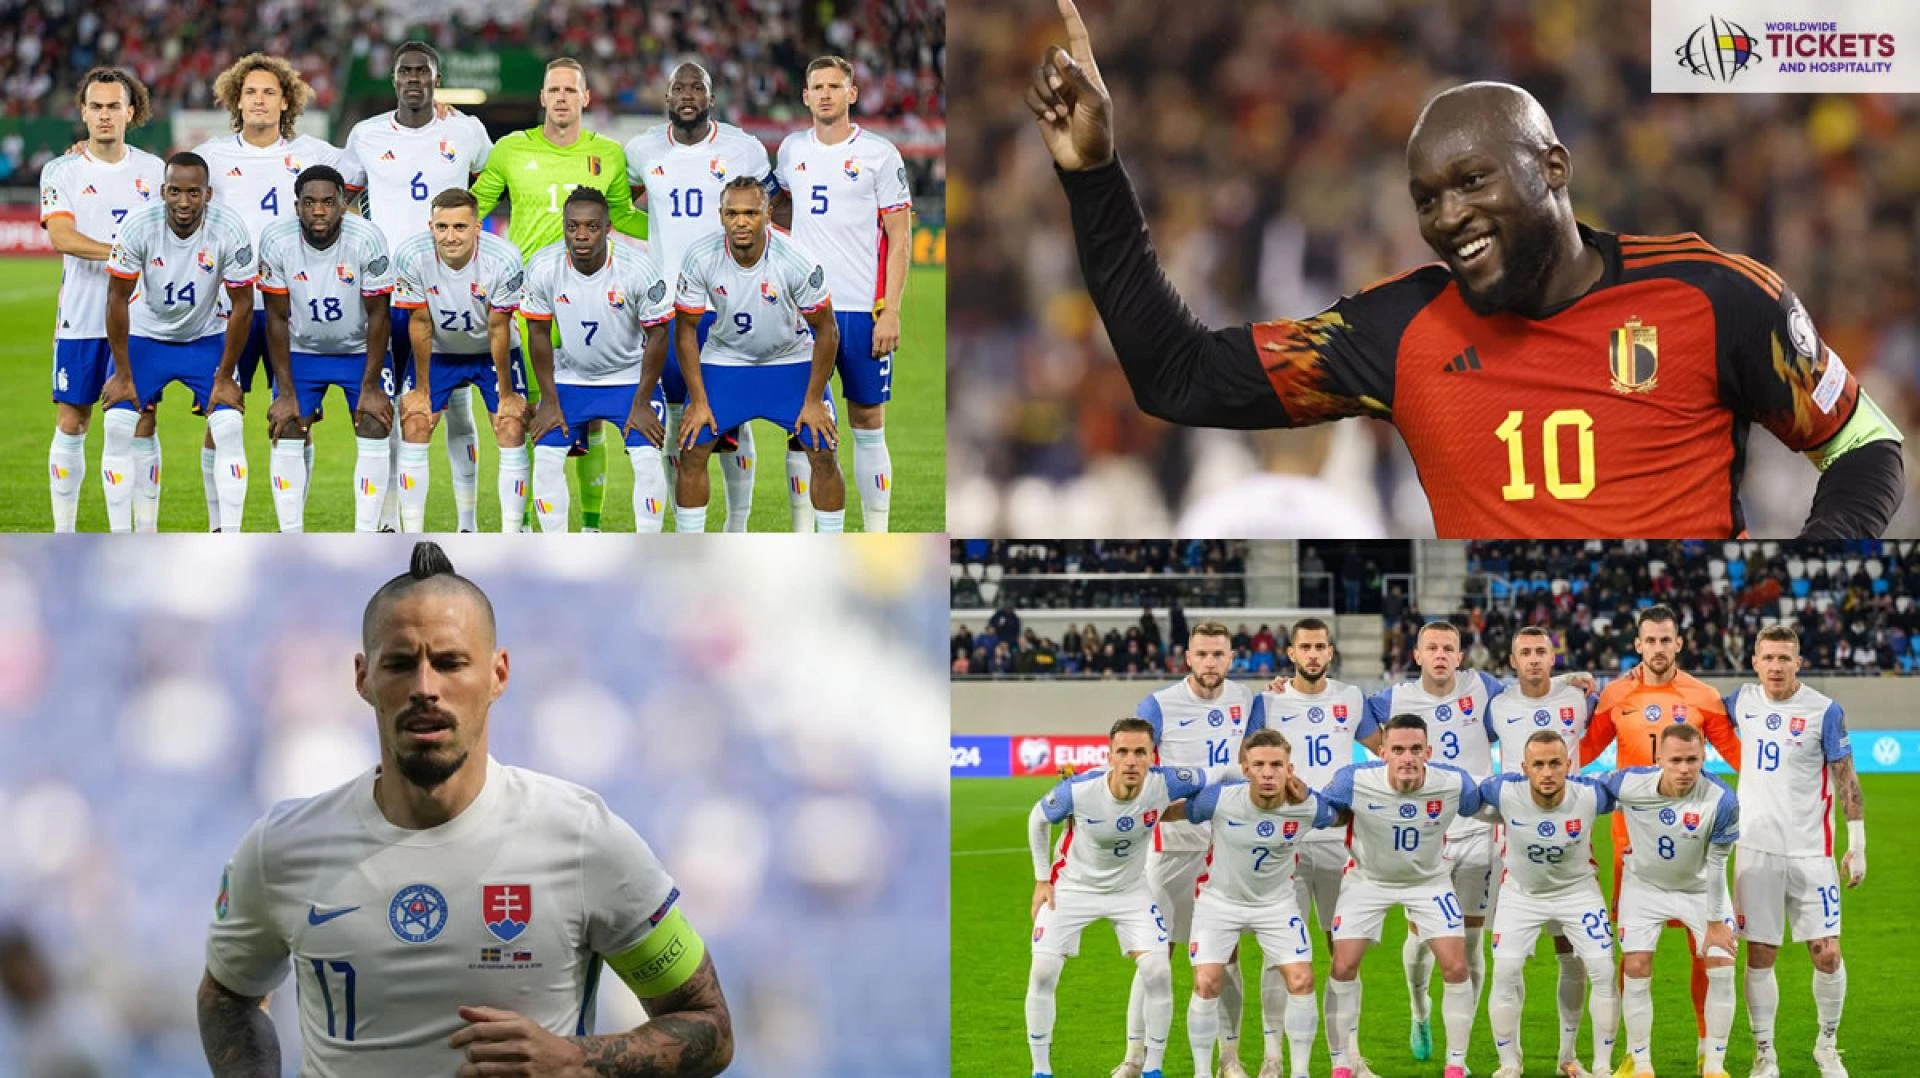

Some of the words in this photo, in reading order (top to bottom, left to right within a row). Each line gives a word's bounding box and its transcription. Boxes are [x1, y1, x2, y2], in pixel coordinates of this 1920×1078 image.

[410, 171, 429, 201] 6
[811, 185, 829, 215] 5
[260, 186, 279, 216] 4
[668, 188, 703, 217] 10
[164, 281, 195, 306] 14
[308, 297, 343, 322] 18
[439, 310, 474, 331] 21
[734, 312, 752, 335] 9
[581, 321, 599, 345] 7
[1493, 409, 1596, 501] 10
[1206, 739, 1229, 767] 14
[1304, 734, 1332, 767] 16
[1440, 731, 1460, 760] 3
[1757, 739, 1779, 771] 19
[1113, 840, 1131, 857] 2
[1392, 825, 1419, 851] 10
[1658, 835, 1675, 860] 8
[1252, 846, 1269, 871] 7
[1527, 844, 1564, 864] 22
[1433, 892, 1462, 921] 10
[1817, 885, 1839, 918] 19
[1289, 917, 1307, 945] 7
[631, 938, 683, 980] RESPECT
[311, 960, 356, 1041] 17
